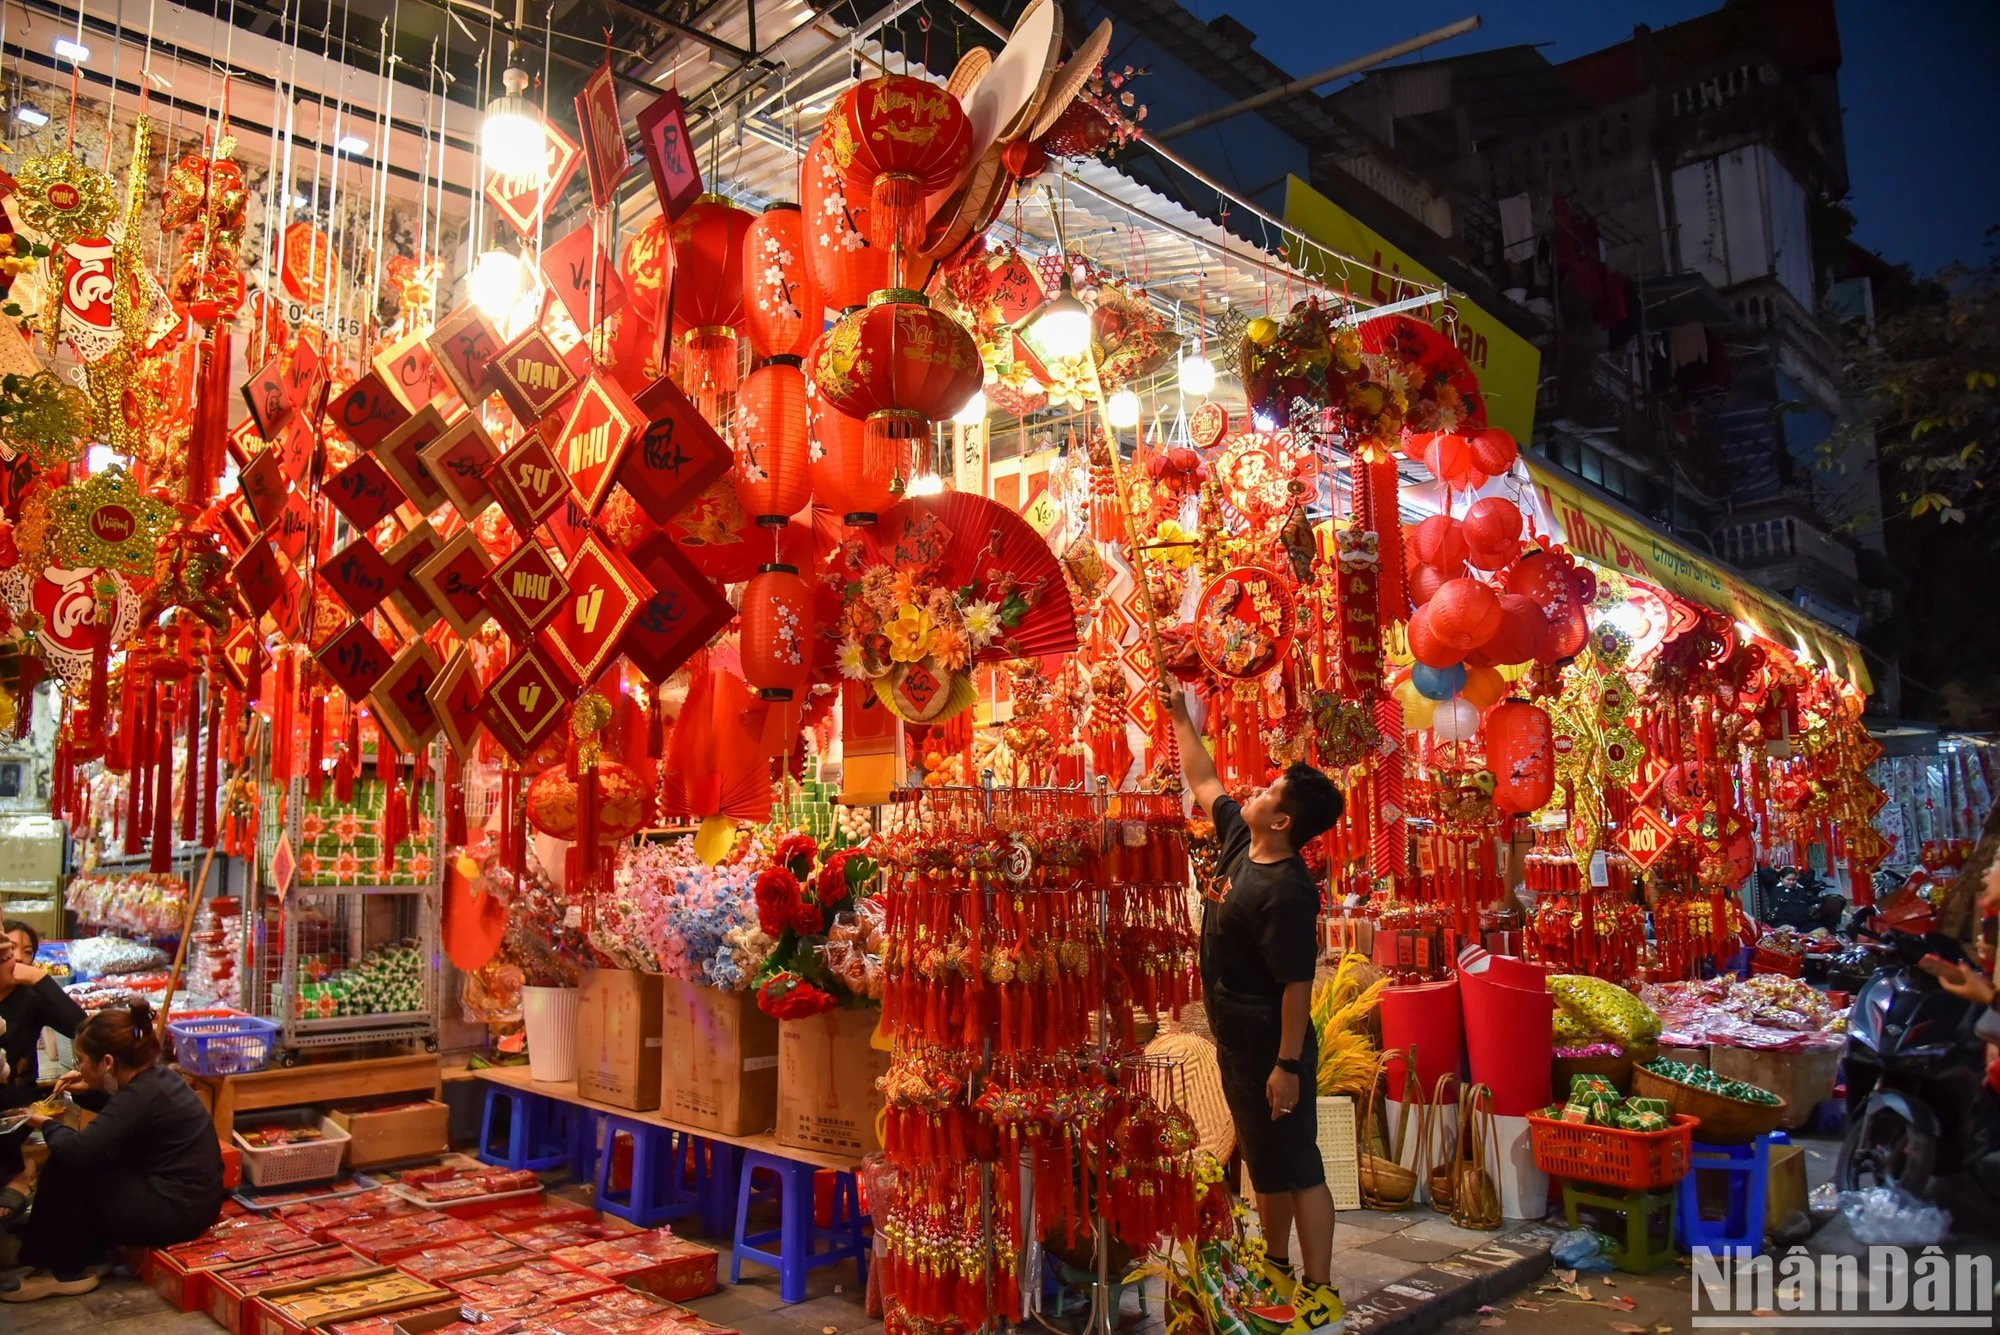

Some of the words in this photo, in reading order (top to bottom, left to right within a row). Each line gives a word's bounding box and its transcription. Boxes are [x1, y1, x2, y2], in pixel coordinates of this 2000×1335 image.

[517, 358, 560, 391] VẠN
[567, 413, 614, 476] NHƯ
[519, 463, 555, 498] SỰ
[512, 570, 553, 601] NHƯ
[576, 583, 605, 634] Ý
[518, 681, 542, 713] Ý
[1627, 823, 1657, 852] MỚI
